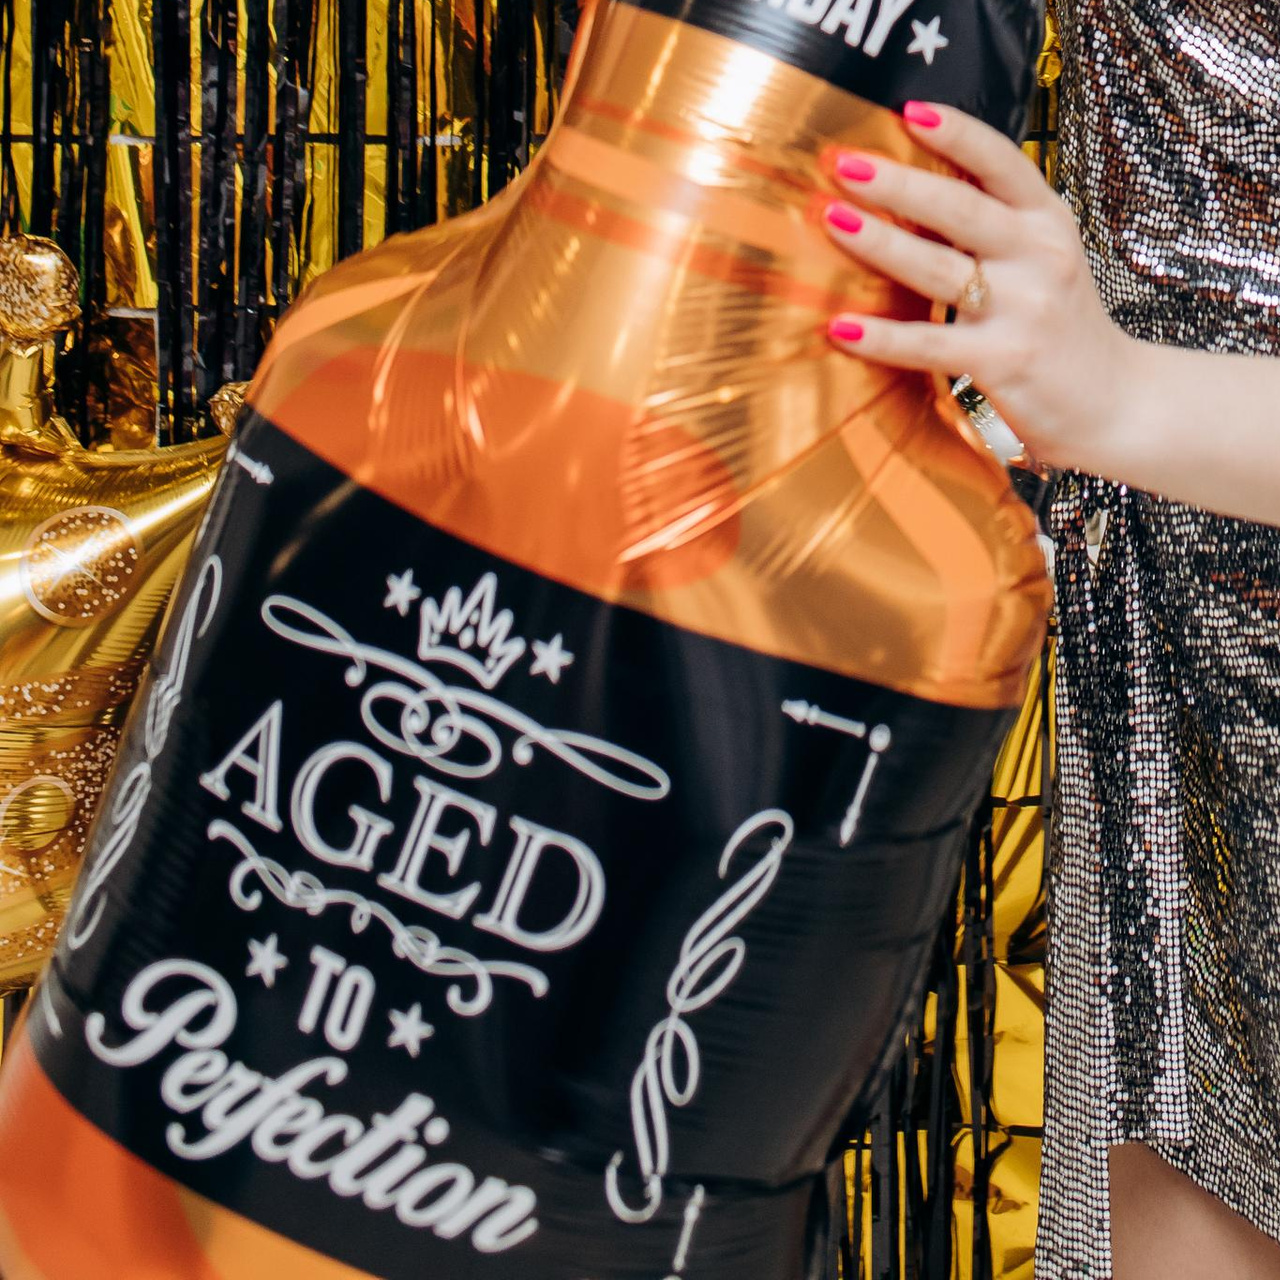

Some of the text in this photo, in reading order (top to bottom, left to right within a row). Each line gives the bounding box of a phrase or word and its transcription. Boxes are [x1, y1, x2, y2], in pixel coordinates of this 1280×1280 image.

[200, 700, 606, 952] AGED
[87, 959, 538, 1252] Perfection
[299, 946, 375, 1050] TO
